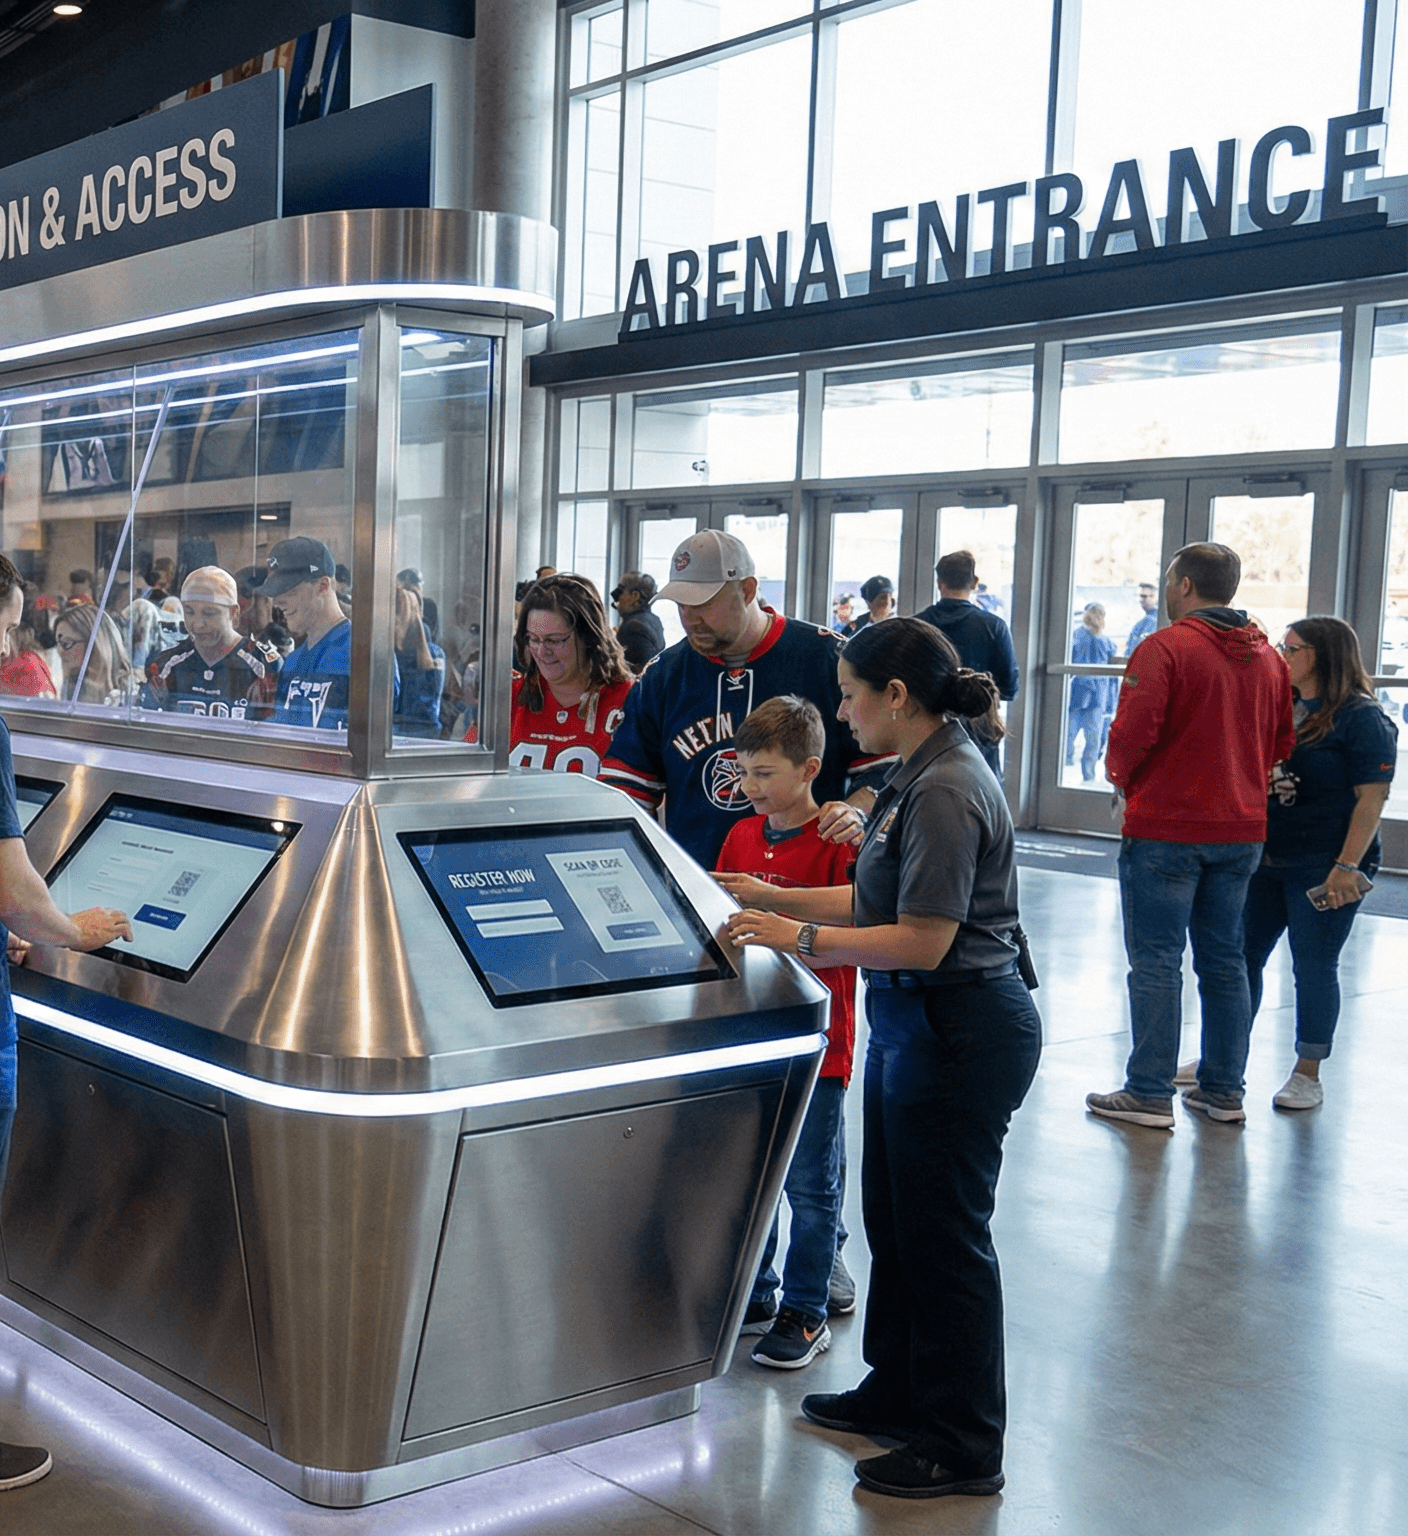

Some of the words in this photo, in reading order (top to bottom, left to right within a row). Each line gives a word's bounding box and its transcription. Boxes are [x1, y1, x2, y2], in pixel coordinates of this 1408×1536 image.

[39, 186, 66, 251] &
[75, 127, 237, 241] ACCESS
[619, 221, 842, 335] ARENA
[868, 107, 1388, 294] ENTRANCE
